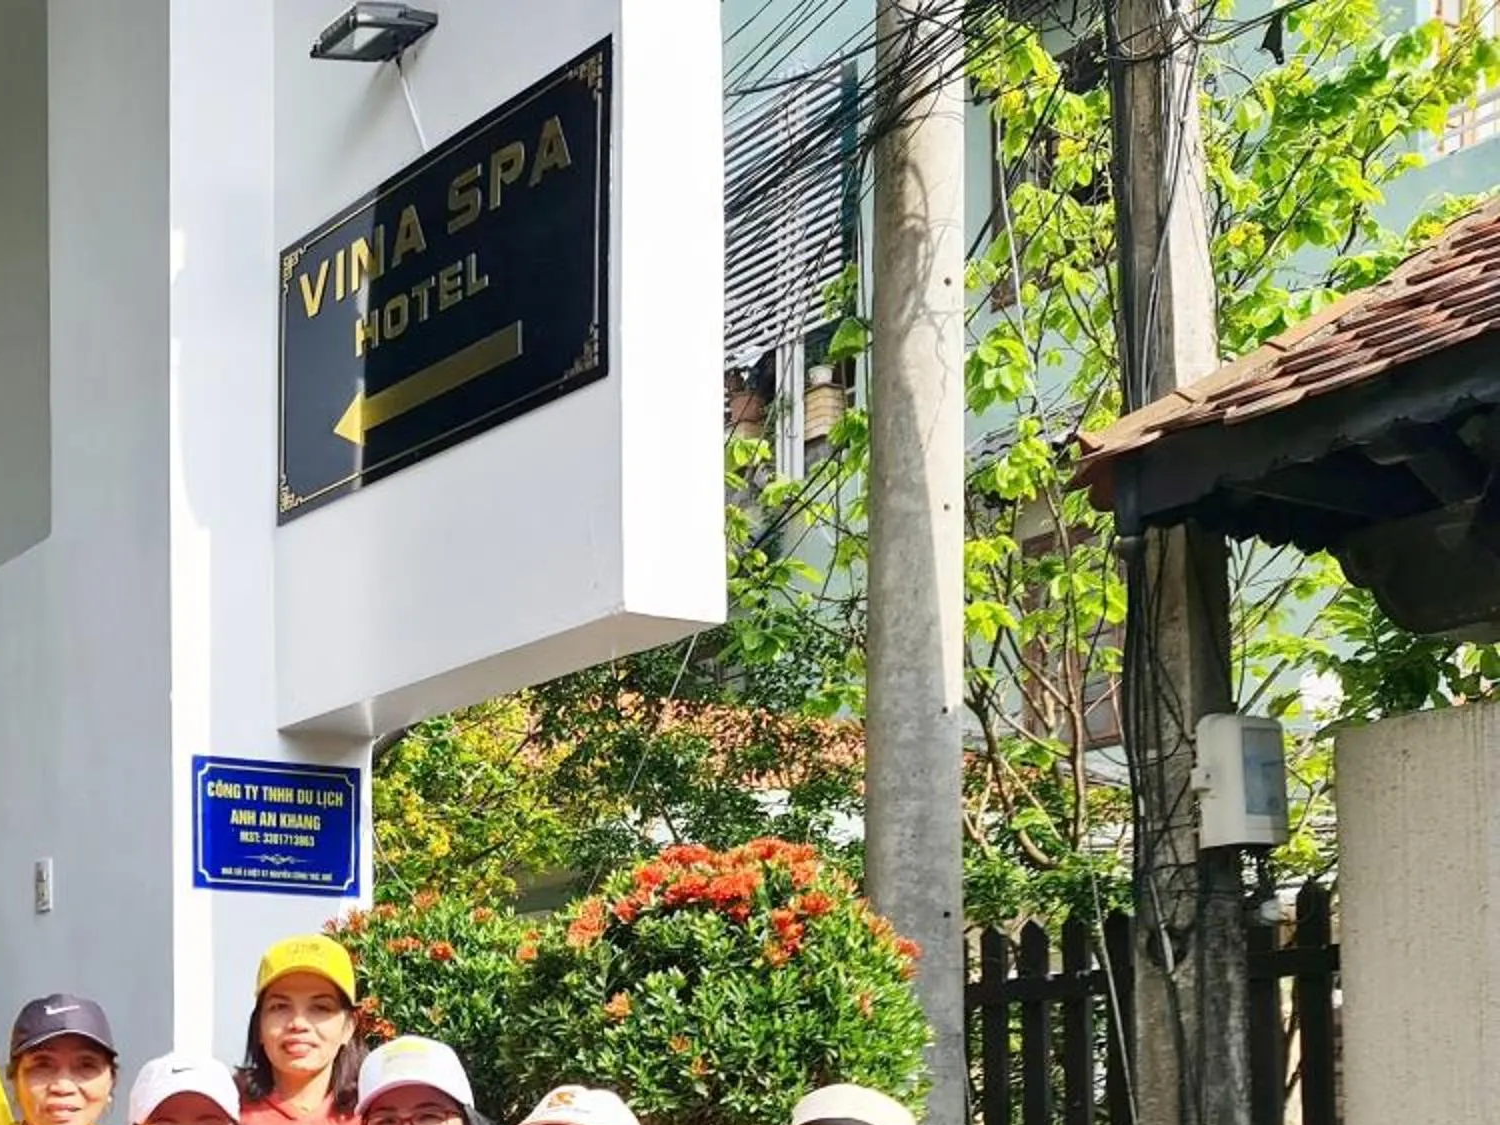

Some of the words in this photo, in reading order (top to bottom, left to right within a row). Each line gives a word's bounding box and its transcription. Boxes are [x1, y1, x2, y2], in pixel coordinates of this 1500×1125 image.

[299, 205, 427, 320] VINA
[447, 115, 572, 235] SPA
[355, 252, 489, 358] HOTEL
[207, 779, 241, 799] CÔNG
[244, 784, 258, 801] TY
[298, 789, 313, 805] DU
[317, 790, 343, 809] LỊCH
[280, 813, 320, 831] KHANG
